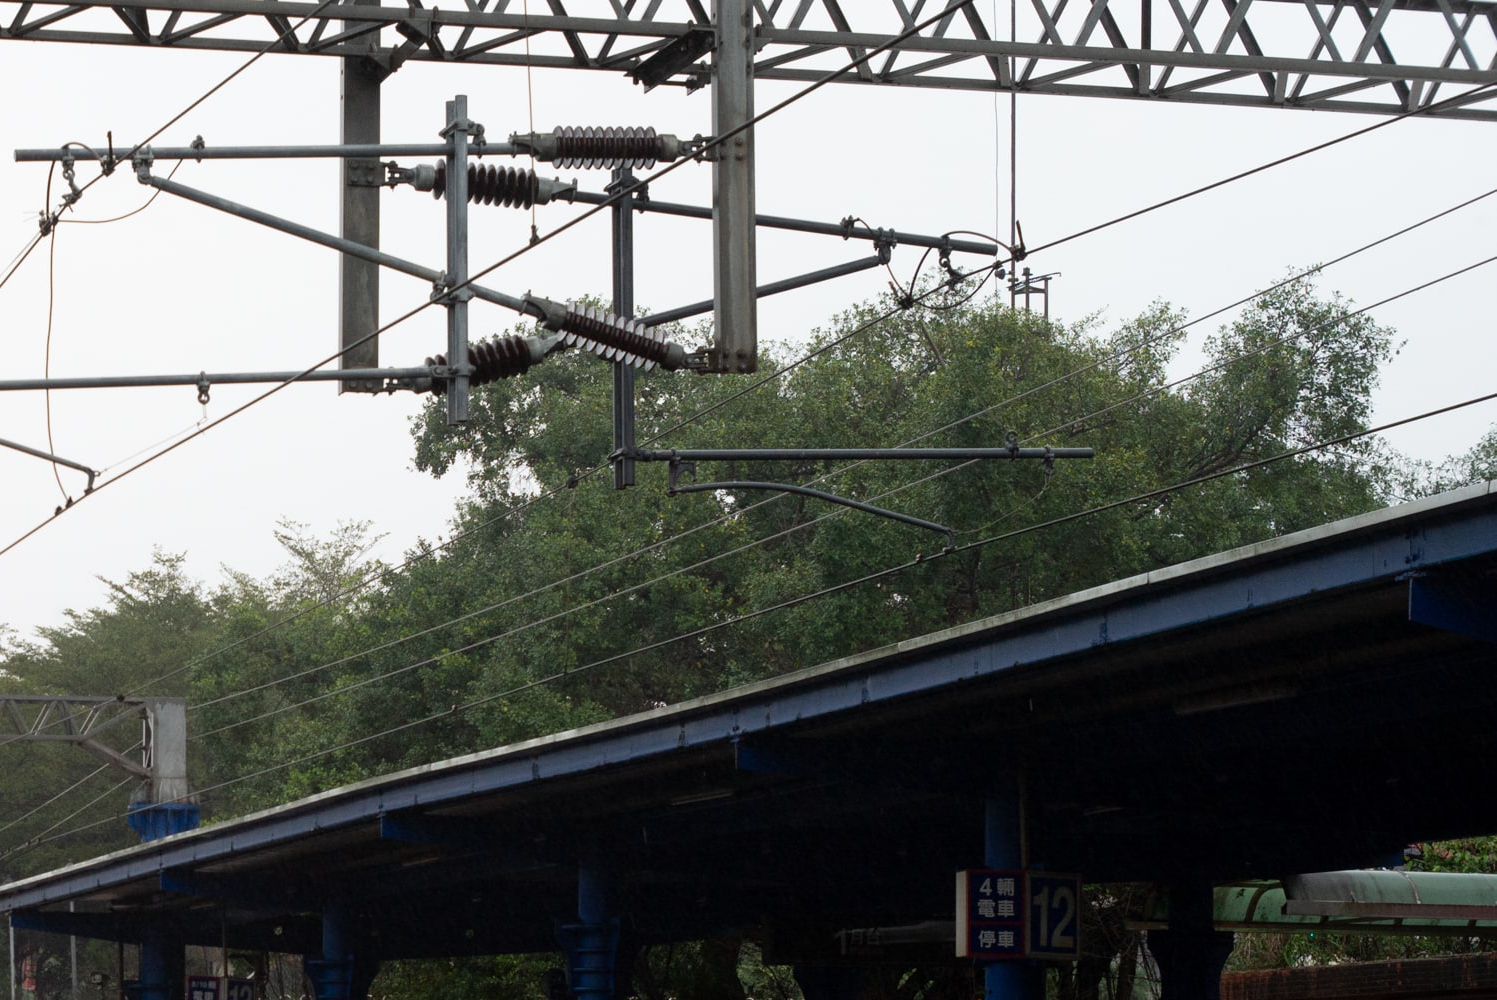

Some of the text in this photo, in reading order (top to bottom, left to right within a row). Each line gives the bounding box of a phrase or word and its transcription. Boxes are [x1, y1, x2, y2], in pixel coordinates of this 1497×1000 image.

[978, 899, 1015, 918] 電車
[1033, 885, 1074, 948] 12
[978, 930, 1014, 948] 停車
